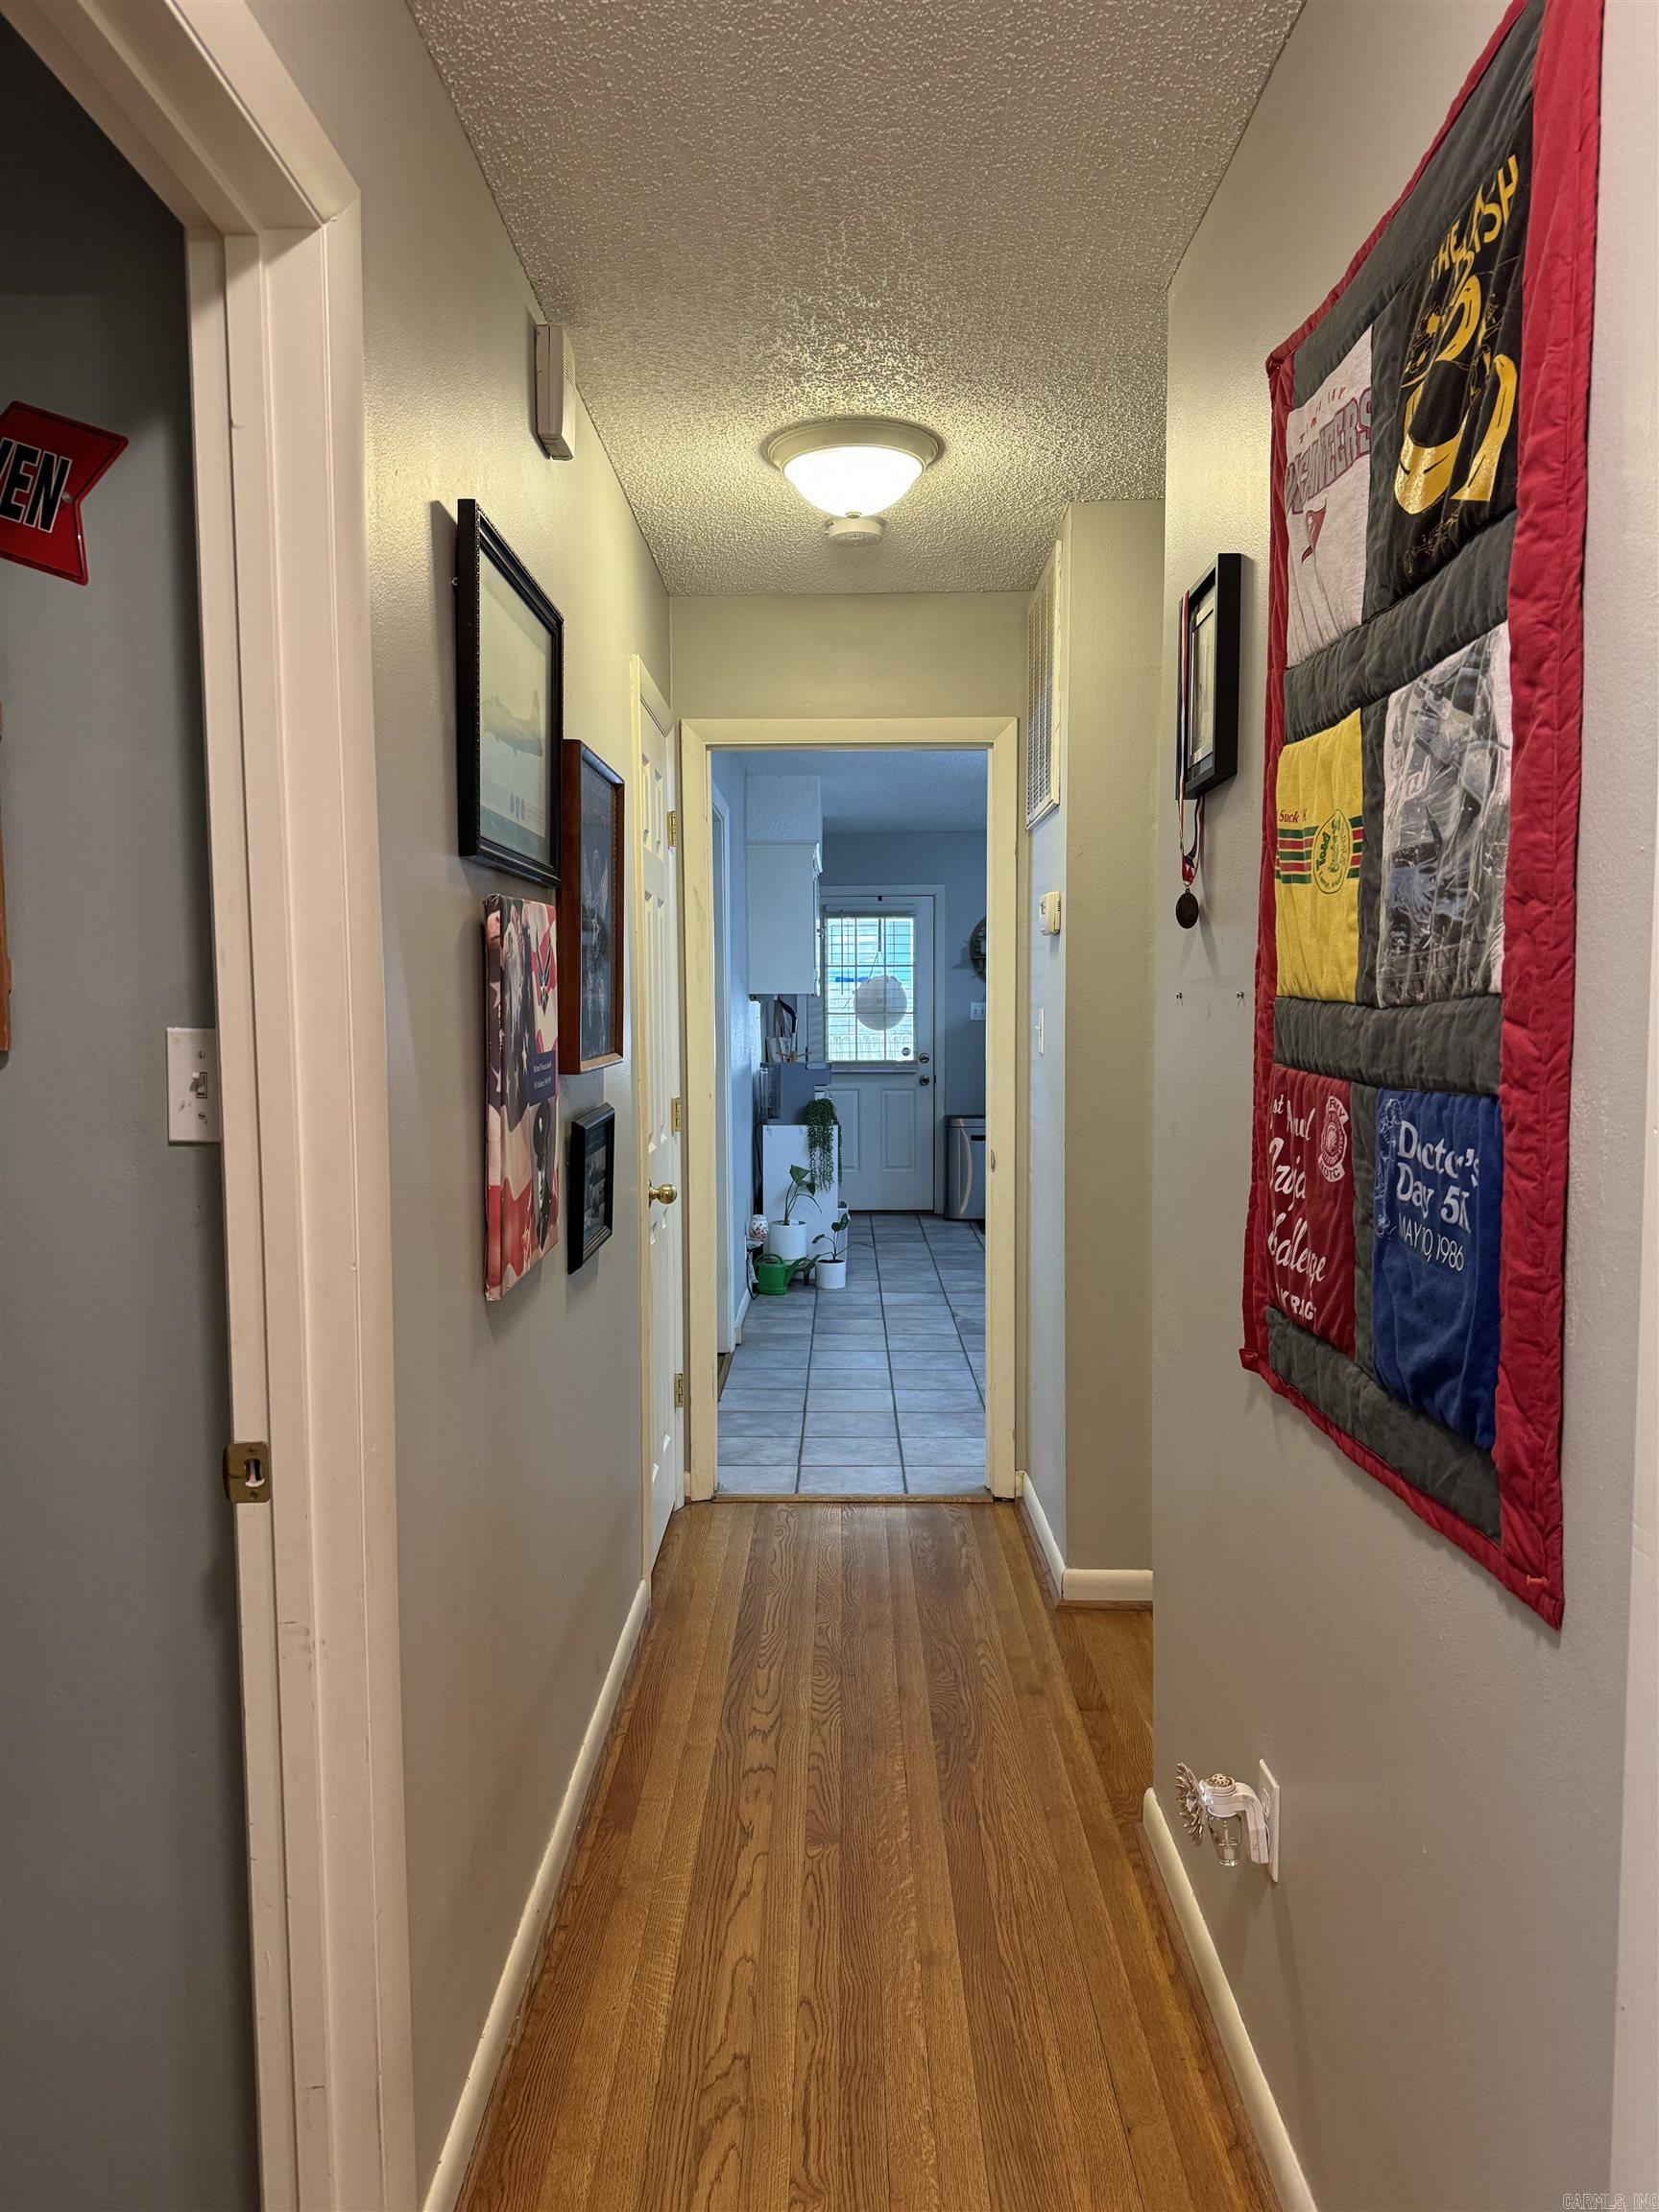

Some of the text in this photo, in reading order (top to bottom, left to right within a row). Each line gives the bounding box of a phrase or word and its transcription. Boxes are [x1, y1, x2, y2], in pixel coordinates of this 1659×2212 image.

[1278, 809, 1301, 824] Suck
[1397, 1162, 1435, 1220] Day
[1399, 1212, 1423, 1249] MAY
[1435, 1233, 1465, 1272] 1986
